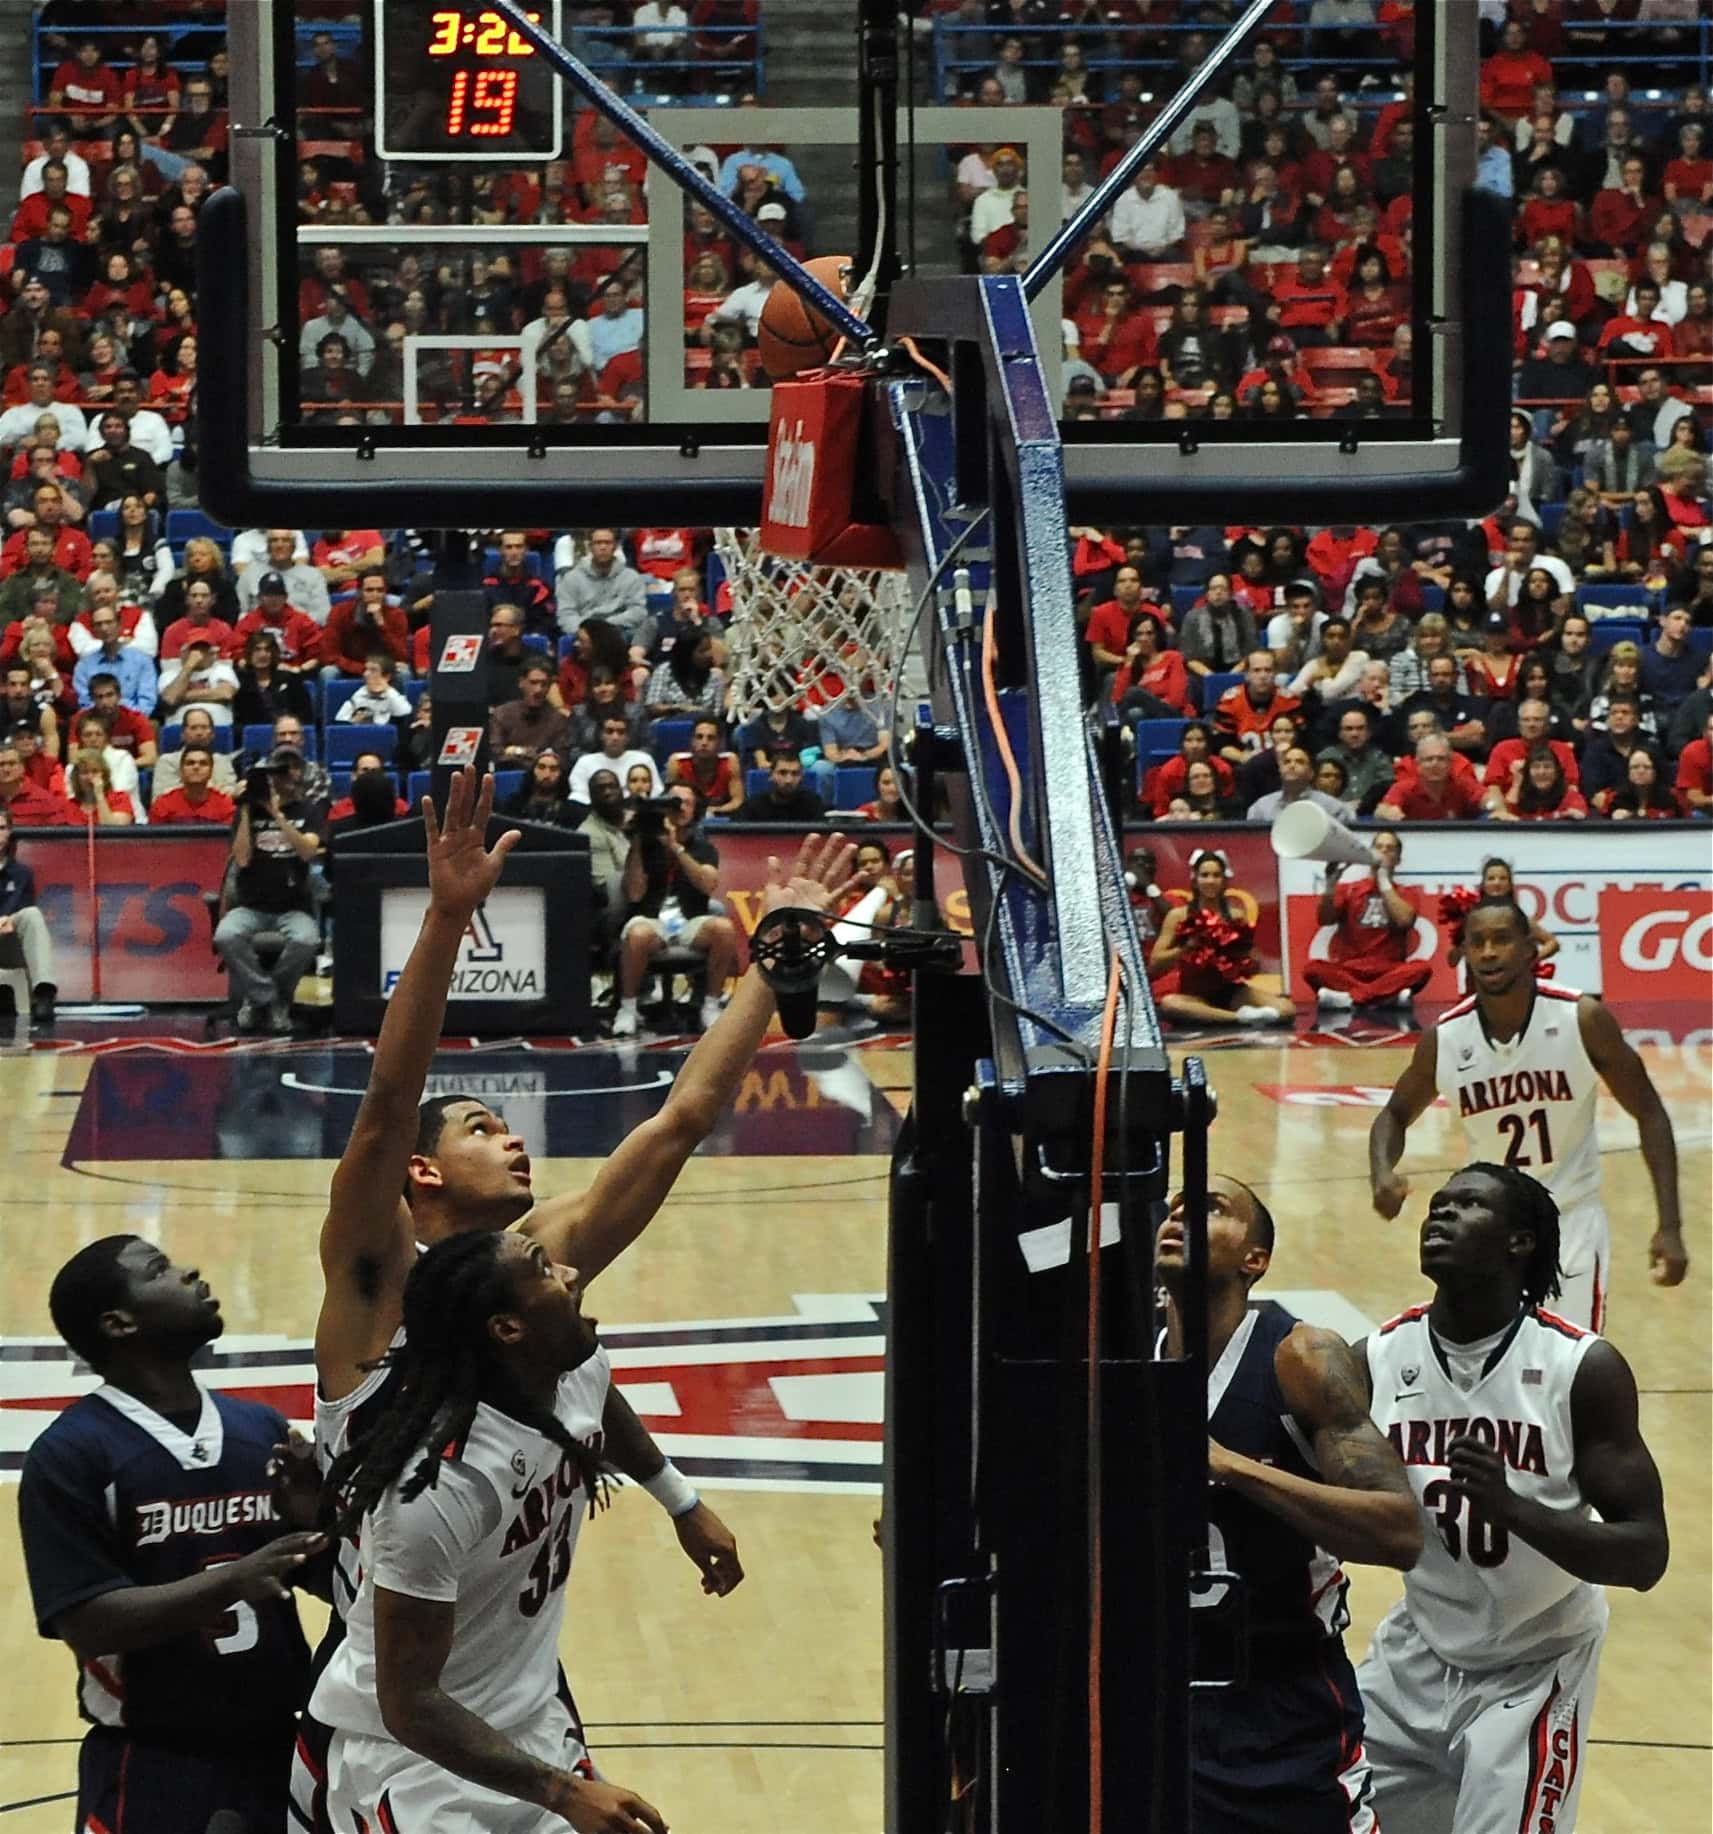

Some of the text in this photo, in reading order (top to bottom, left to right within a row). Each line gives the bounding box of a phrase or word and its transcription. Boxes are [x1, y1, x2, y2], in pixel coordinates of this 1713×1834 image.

[447, 69, 518, 135] 19
[448, 968, 539, 994] RIZONA
[1457, 1069, 1575, 1119] ARIZONA
[1496, 1107, 1554, 1168] 21
[1386, 1416, 1550, 1478] ARIZONA
[135, 1493, 281, 1547] DUQUESN
[1422, 1479, 1510, 1569] 30
